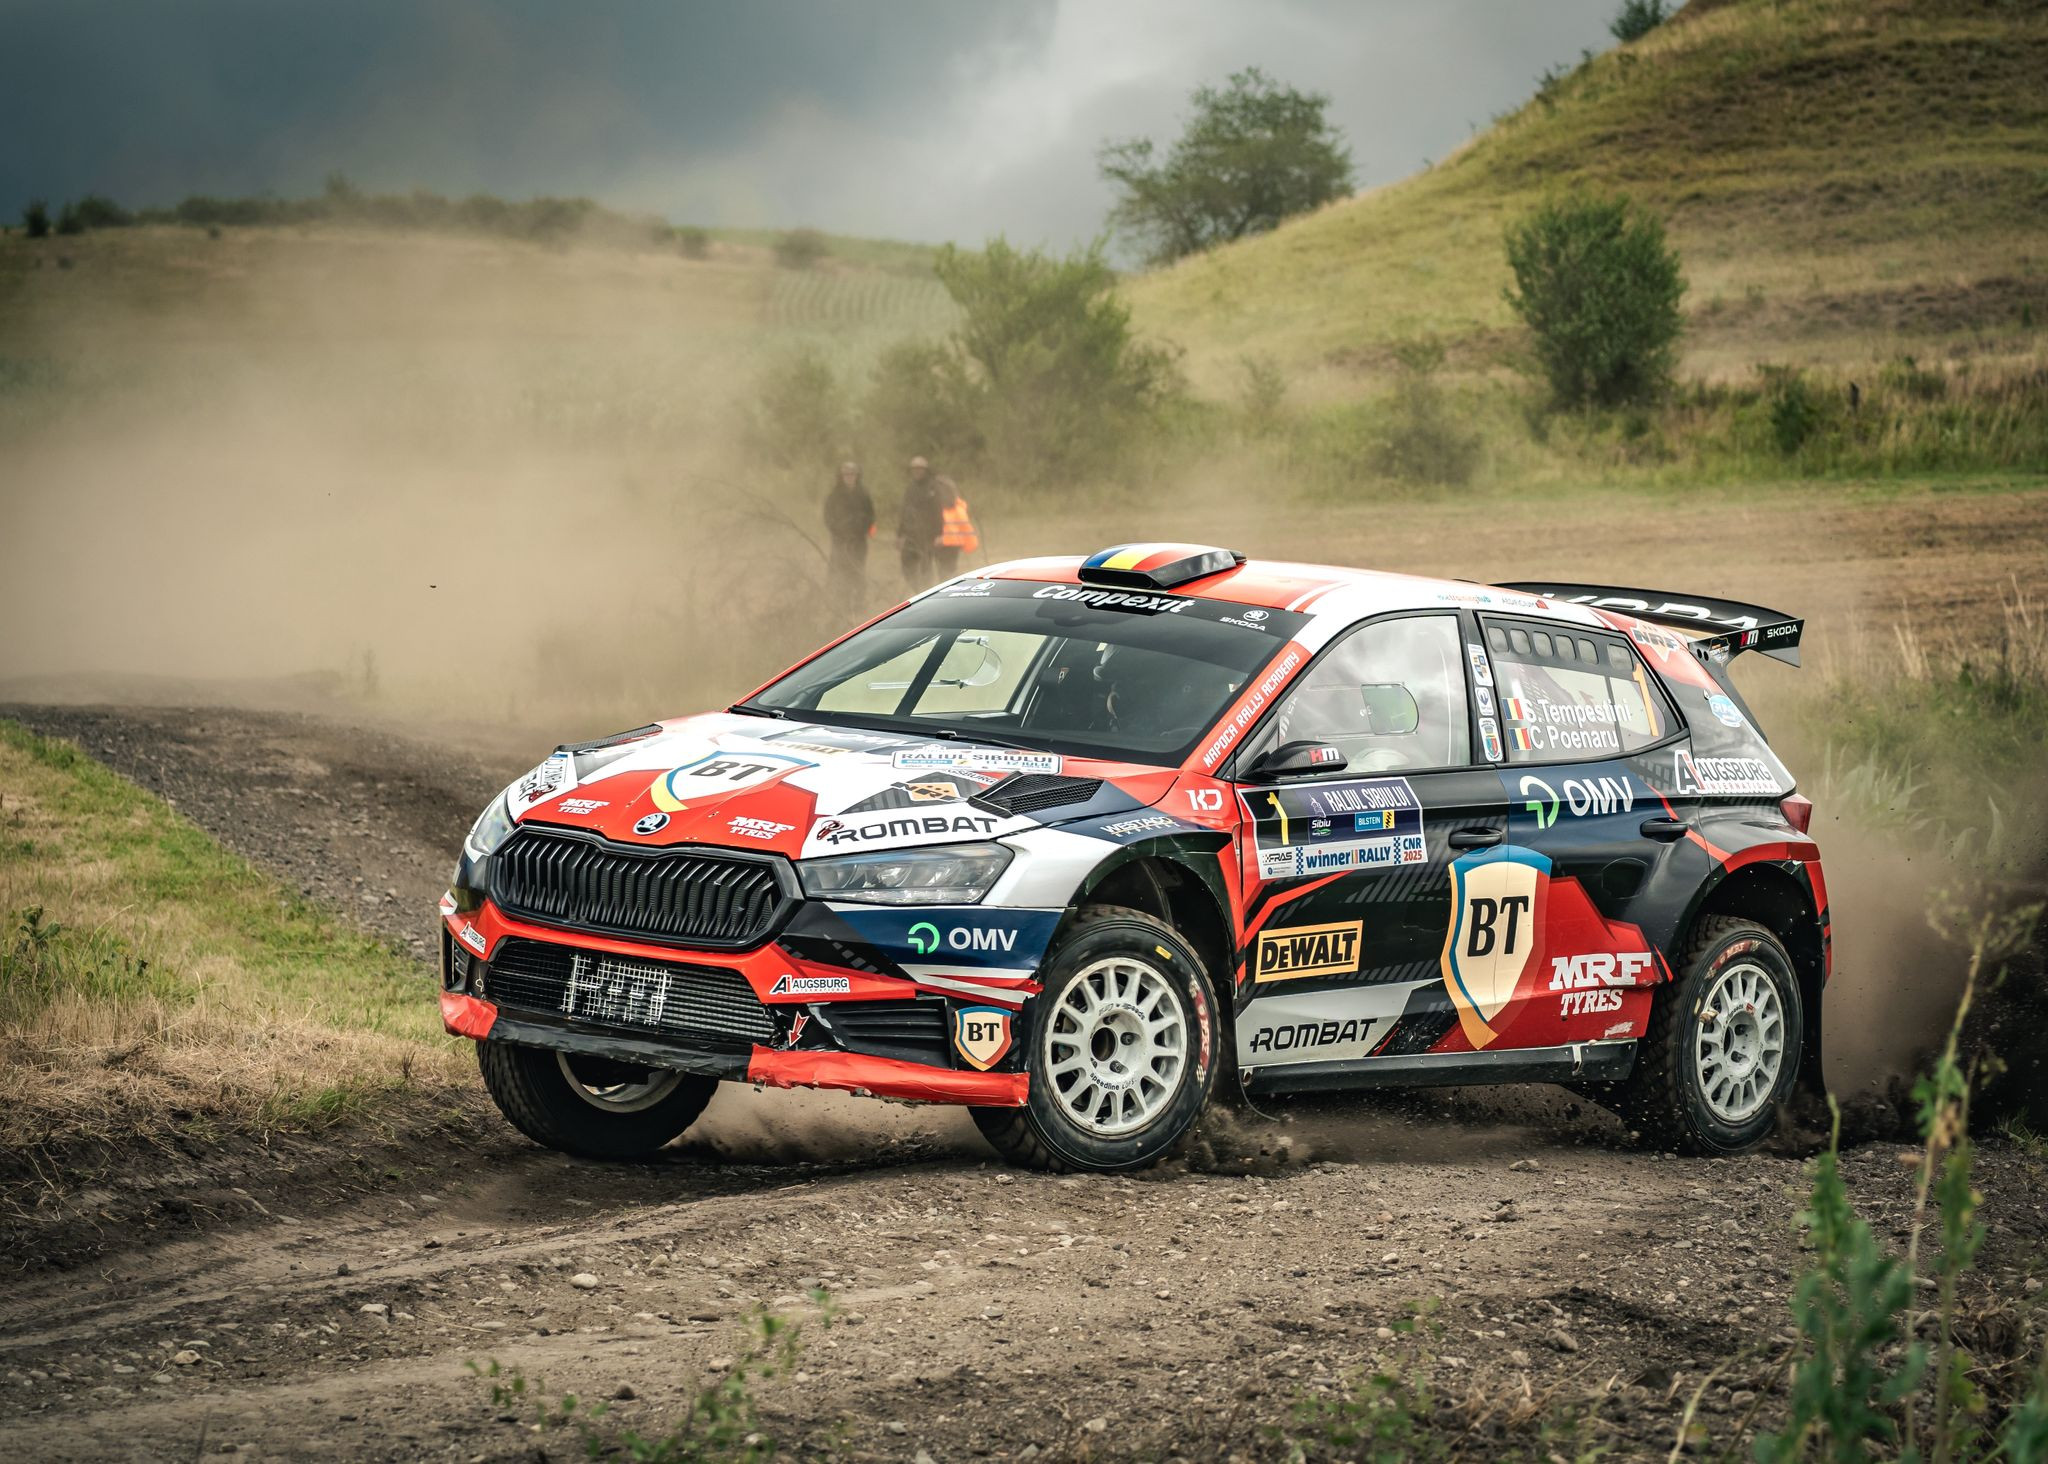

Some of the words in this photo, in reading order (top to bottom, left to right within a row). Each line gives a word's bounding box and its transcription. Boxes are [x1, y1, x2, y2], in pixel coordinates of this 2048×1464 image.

[1033, 585, 1195, 612] Compexit
[1220, 617, 1265, 631] SKODA
[1767, 624, 1798, 639] SKODA
[1203, 723, 1239, 768] NAPOCA
[1235, 692, 1264, 728] RALLY
[1261, 652, 1300, 697] ACADEMY
[1632, 663, 1659, 736] 1
[1547, 727, 1619, 750] Poenaru
[972, 754, 1052, 763] SIBIULUI
[689, 760, 777, 781] BT
[1697, 761, 1772, 781] AUGSBURG
[558, 798, 610, 809] MRF
[1323, 788, 1368, 812] RALIUL
[1361, 785, 1411, 809] SIBIULUI
[1563, 776, 1634, 817] OMV
[726, 816, 796, 834] MRF
[1266, 792, 1289, 845] 1
[1311, 819, 1331, 829] Sibiu
[1358, 816, 1381, 827] BILSTEIN
[730, 826, 776, 840] TYRES
[827, 817, 998, 845] ROMBAT
[1403, 837, 1422, 851] CNR
[1306, 849, 1351, 869] winner
[1359, 846, 1391, 864] RALLY
[1403, 850, 1423, 862] 2025
[1467, 895, 1529, 957] BT
[948, 927, 1018, 951] OMV
[1549, 952, 1651, 990] MRF
[793, 979, 848, 989] AUGSBURG
[1560, 989, 1623, 1016] TYRES
[967, 1022, 1000, 1042] BT
[1250, 1018, 1378, 1053] ROMBAT
